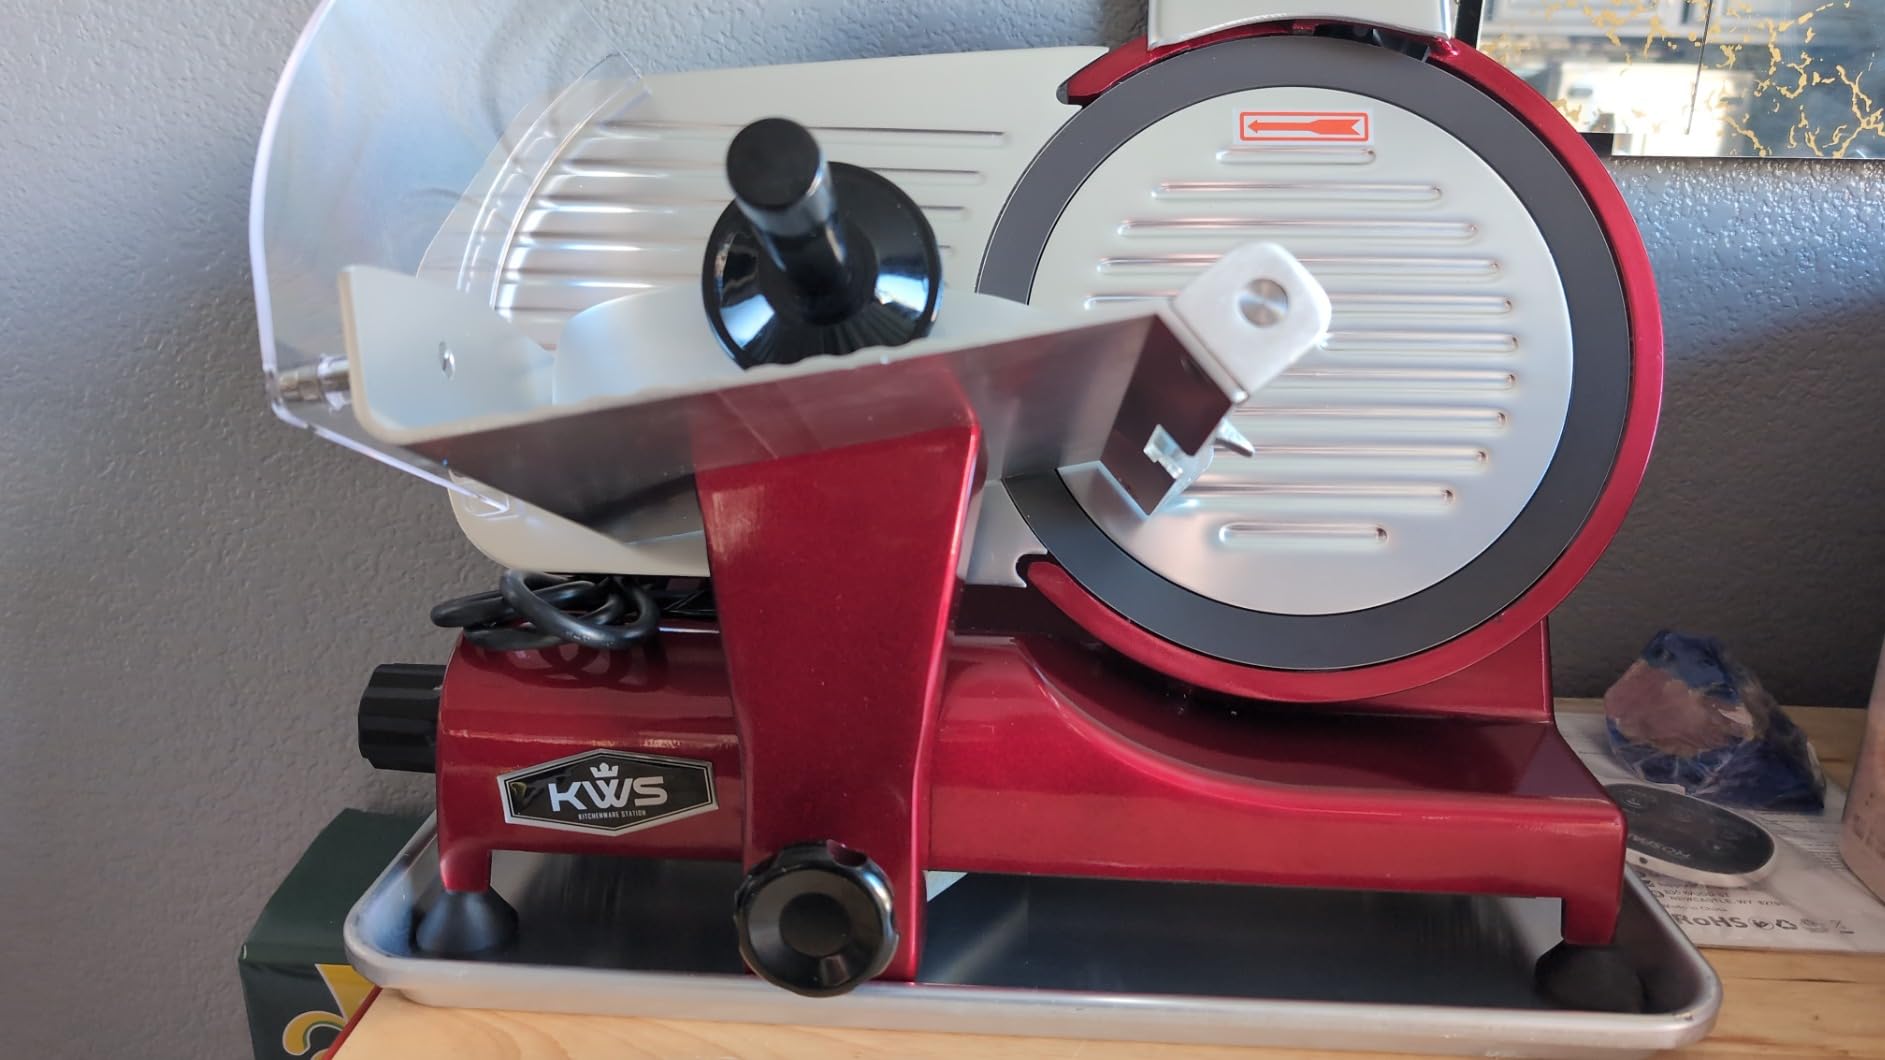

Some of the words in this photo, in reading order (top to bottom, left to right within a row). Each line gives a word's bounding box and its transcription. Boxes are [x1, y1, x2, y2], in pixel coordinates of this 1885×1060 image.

[548, 776, 669, 812] KWS
[577, 811, 620, 820] KITCHENWARE
[620, 809, 647, 818] STATION
[1670, 913, 1749, 929] RoHS
